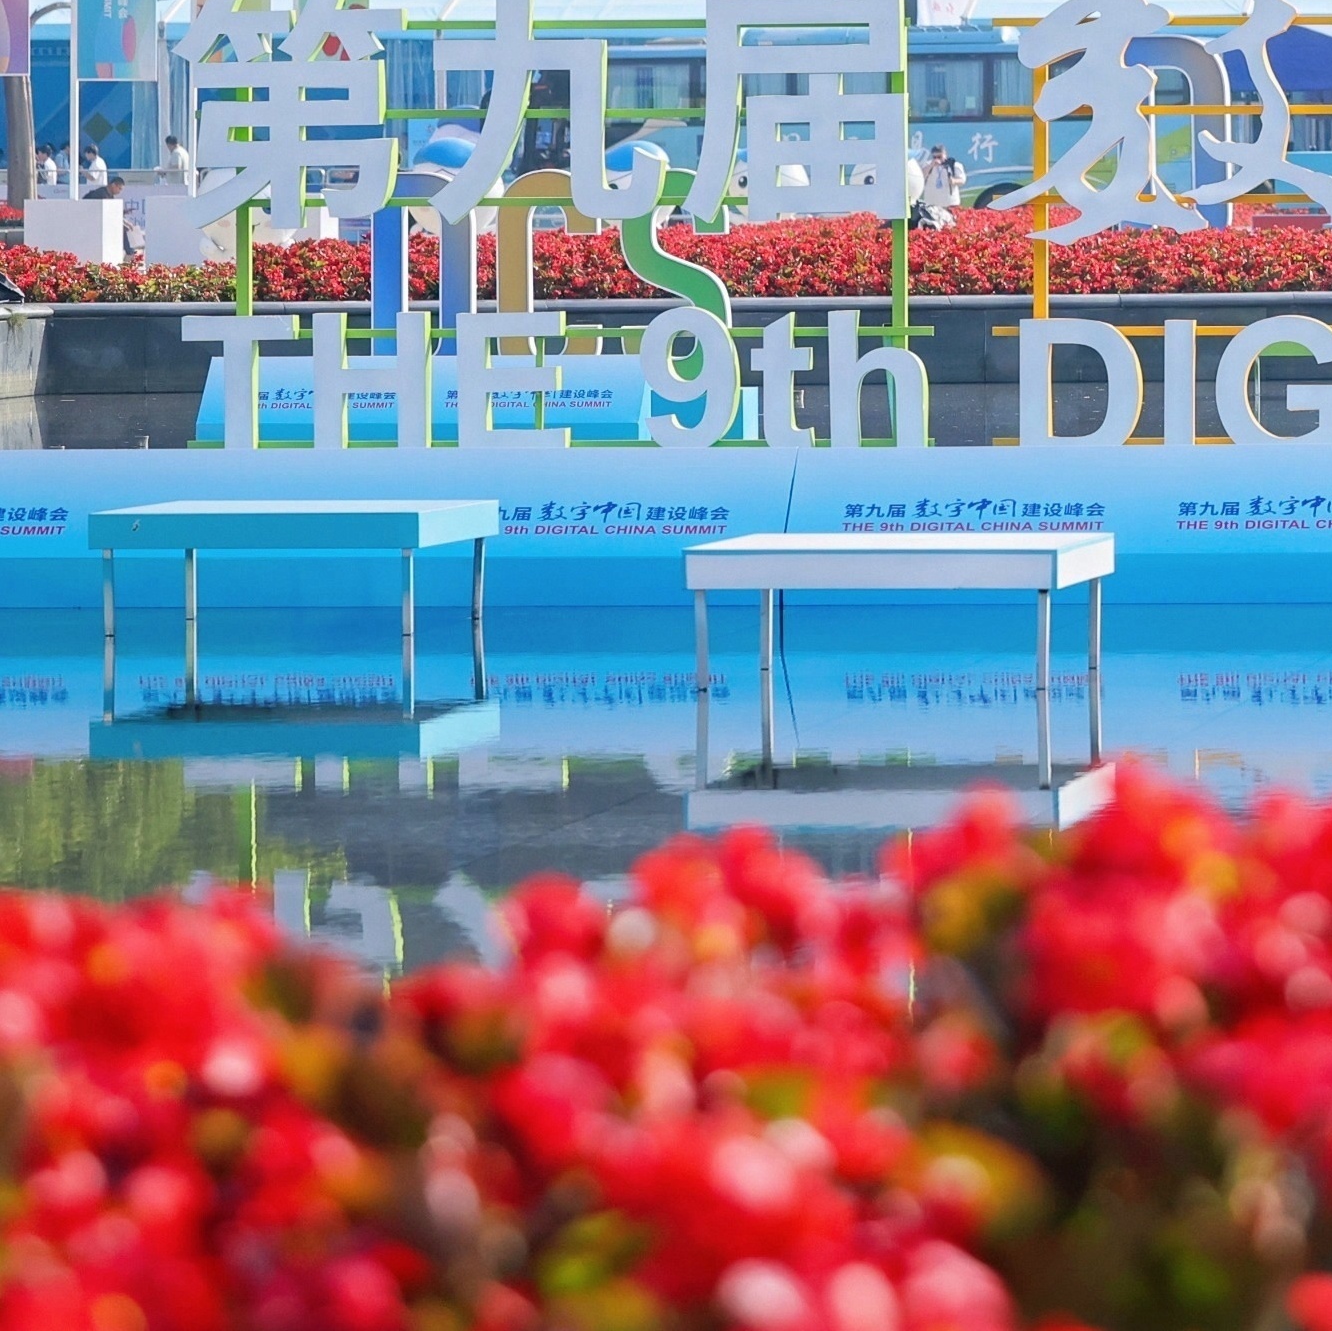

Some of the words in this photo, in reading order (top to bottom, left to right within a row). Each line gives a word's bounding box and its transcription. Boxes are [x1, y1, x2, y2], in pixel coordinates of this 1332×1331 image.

[181, 311, 568, 450] THE
[640, 306, 929, 450] 9th
[843, 498, 1106, 520] 第九届数字中国建设峰会
[0, 525, 66, 536] SUMMIT
[503, 525, 529, 535] 9th
[533, 524, 600, 535] DIGITAL
[604, 524, 657, 535] CHINA
[661, 524, 728, 535] SUMMIT
[841, 522, 875, 532] THE
[879, 521, 905, 532] 9th
[909, 521, 976, 532] DIGITAL
[980, 521, 1033, 532] CHINA
[1037, 520, 1105, 532] SUMMIT
[1175, 520, 1209, 531] THE
[1214, 519, 1239, 530] 9th
[1244, 519, 1311, 530] DIGITAL
